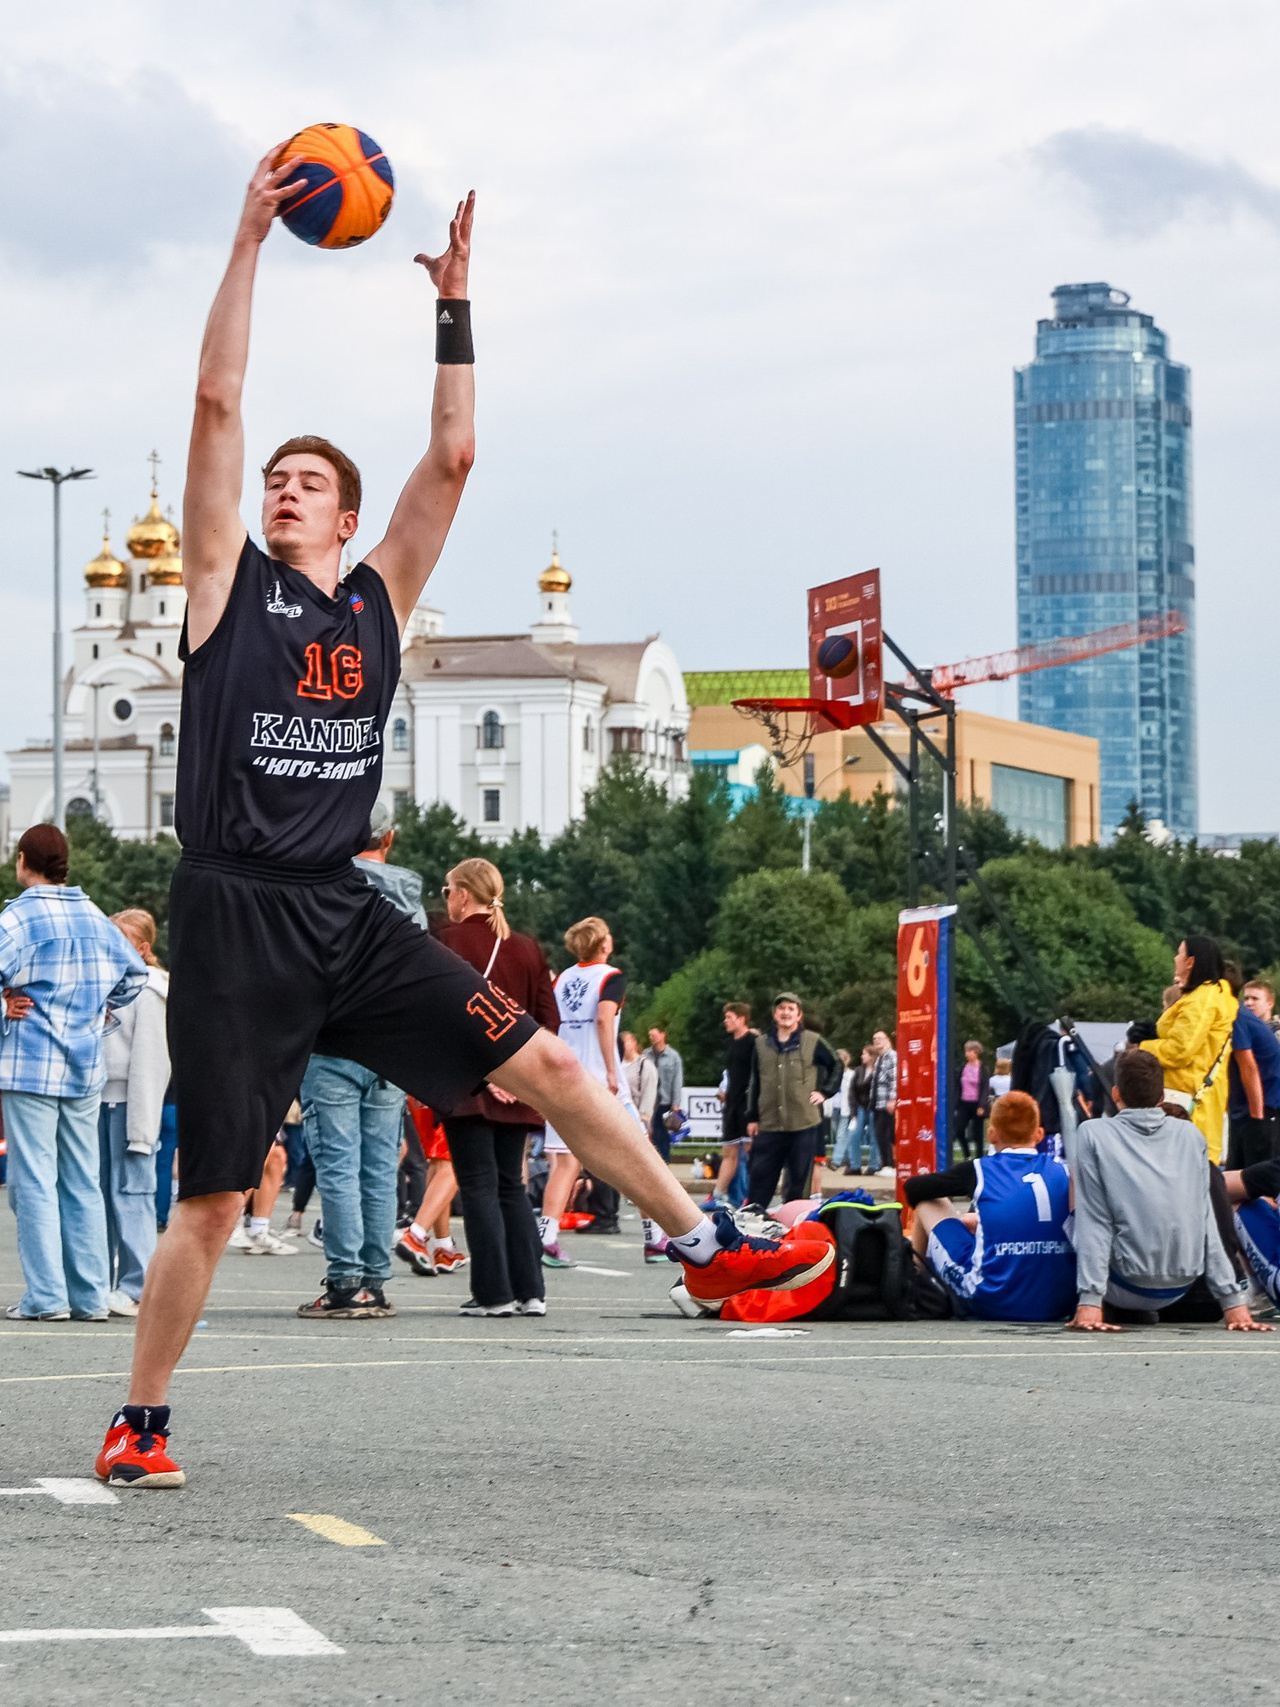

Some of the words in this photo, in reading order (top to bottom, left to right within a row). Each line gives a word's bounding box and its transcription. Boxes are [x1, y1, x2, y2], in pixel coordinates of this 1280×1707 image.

[297, 642, 364, 700] 16
[907, 926, 927, 997] 6
[1022, 1172, 1052, 1222] 1
